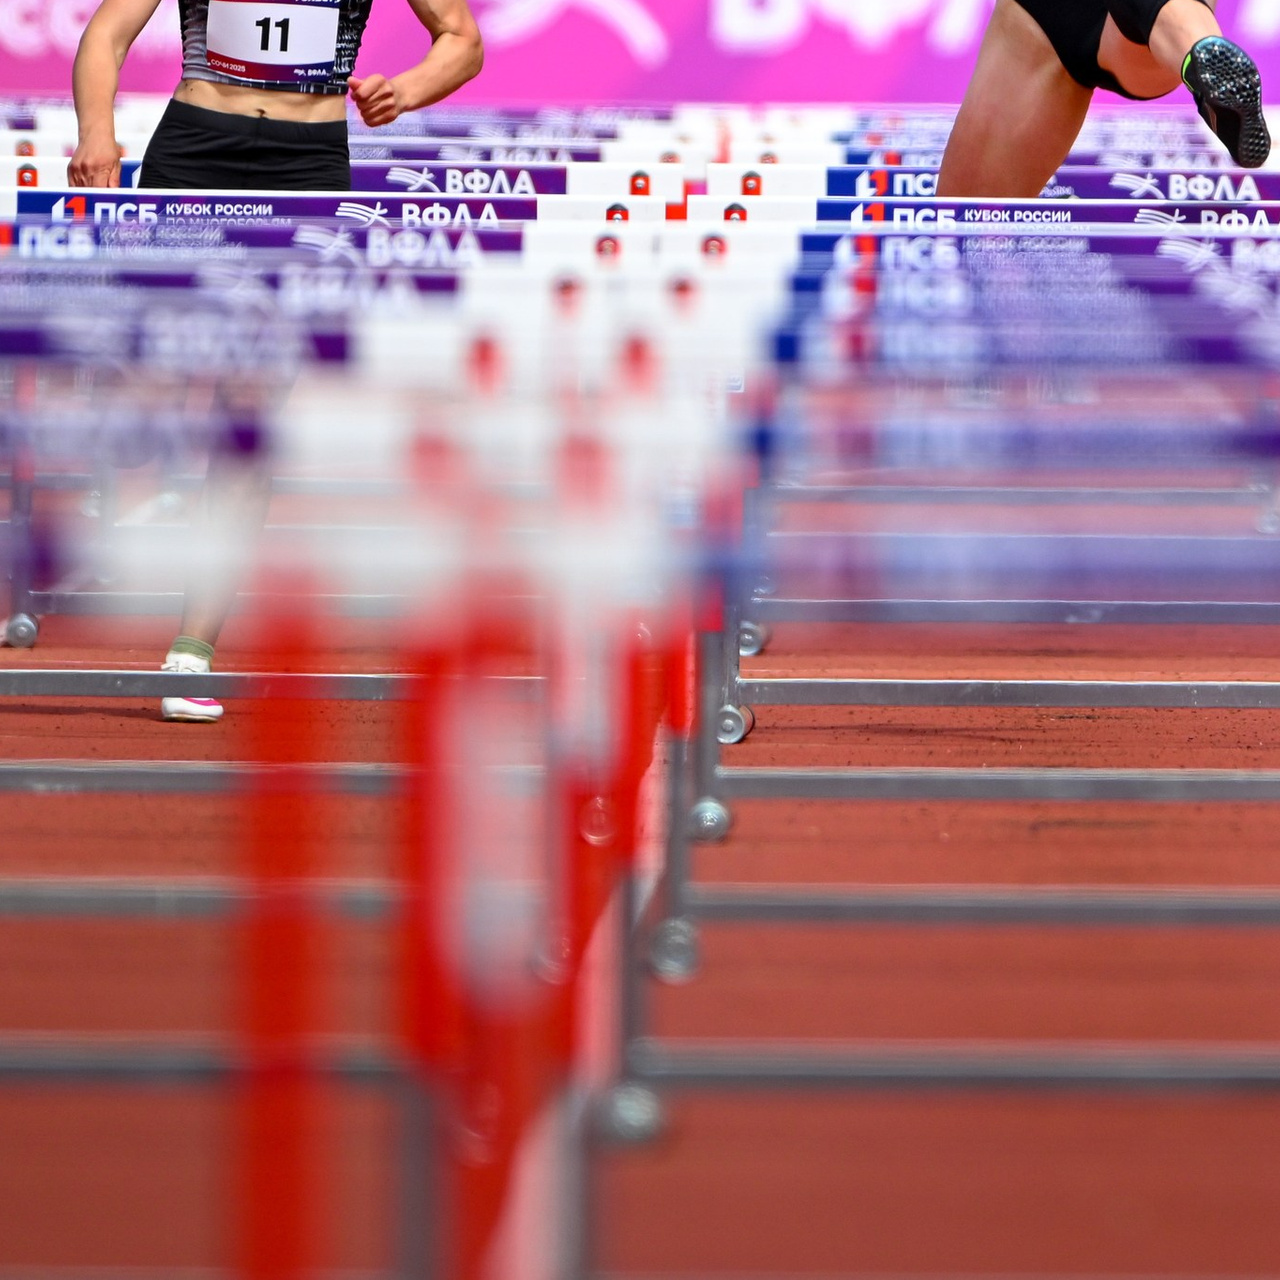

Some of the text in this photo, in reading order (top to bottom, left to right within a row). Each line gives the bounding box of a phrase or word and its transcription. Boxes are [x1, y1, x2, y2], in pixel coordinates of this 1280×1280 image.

[255, 17, 290, 52] 11
[445, 169, 536, 194] ВФЛА
[893, 172, 939, 195] ПС
[1168, 173, 1261, 201] ВФЛА
[94, 202, 158, 225] ПСБ
[166, 204, 273, 215] КУБОК РОССИИ
[402, 202, 499, 228] ВФЛА
[893, 208, 957, 233] ПСБ
[965, 209, 1071, 222] КУБОК РОССИИ
[18, 227, 95, 260] ПСБ
[365, 228, 482, 267] ВФЛА
[882, 235, 961, 270] ПСБ
